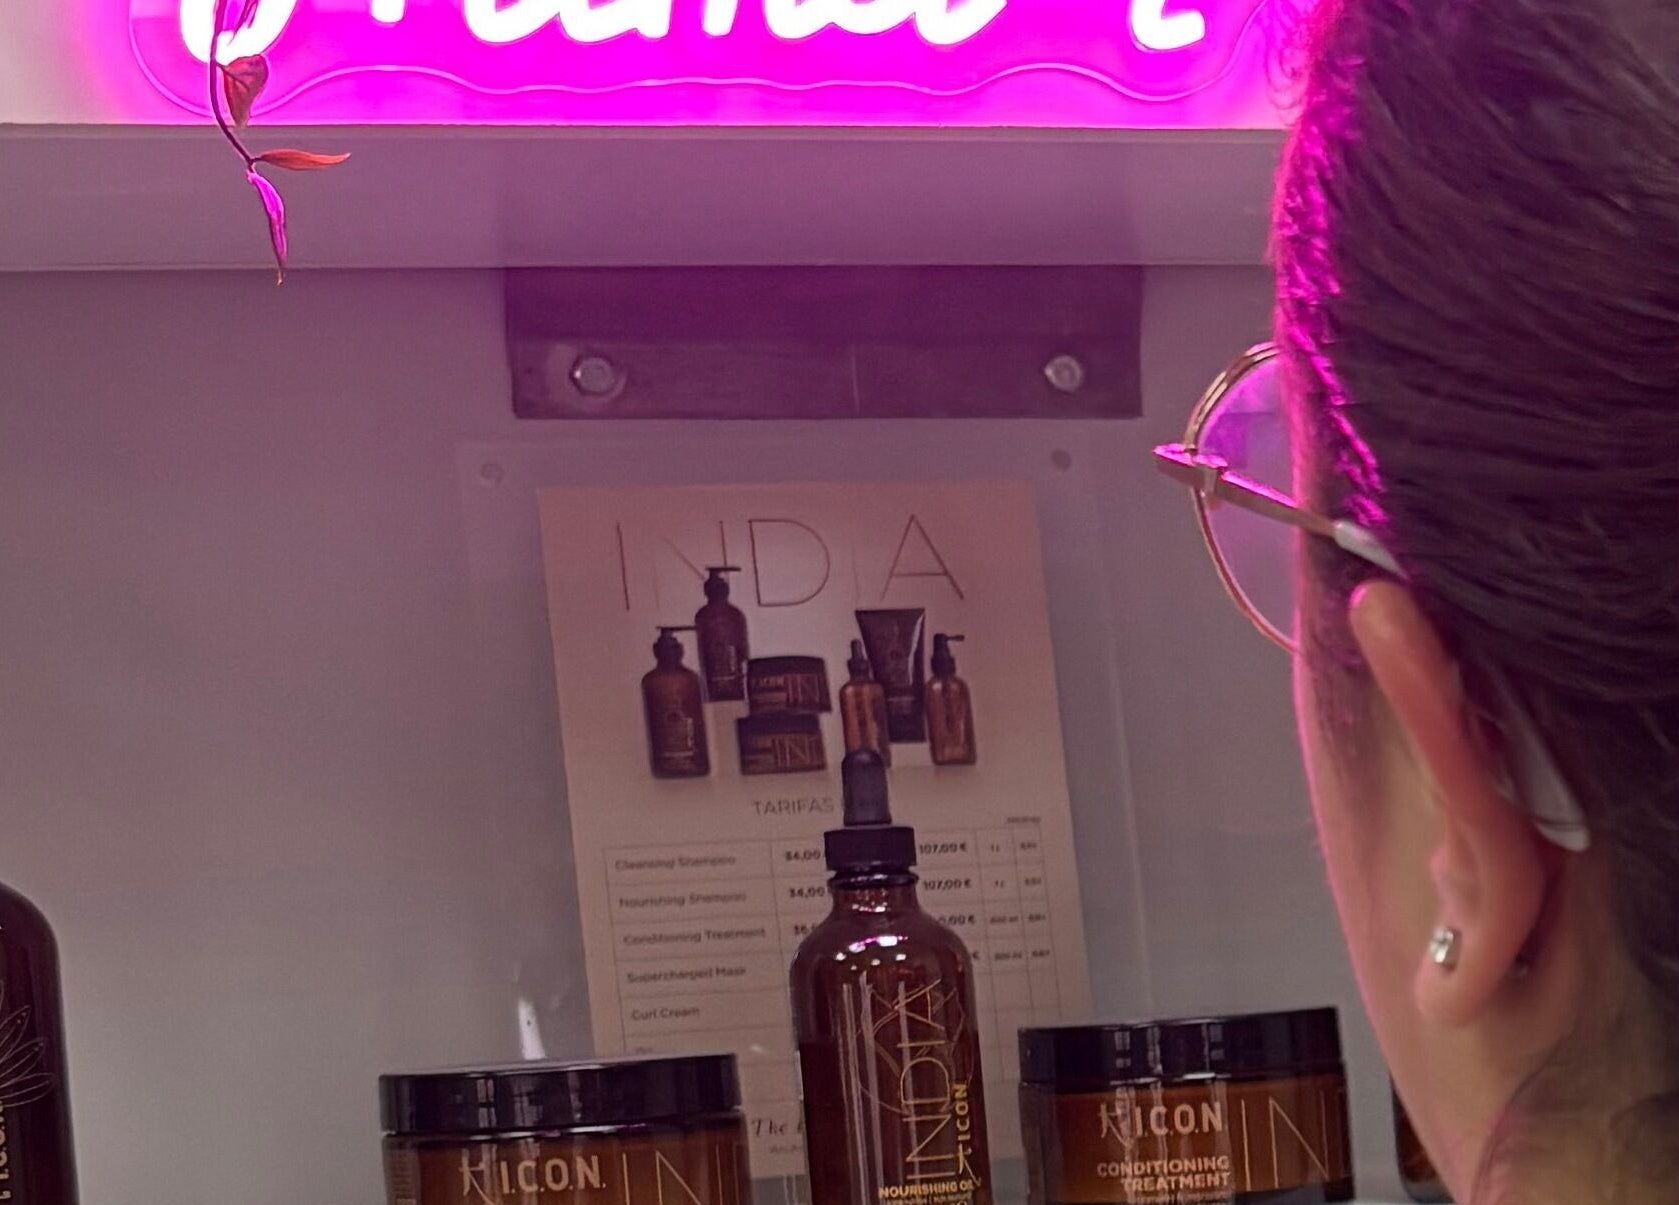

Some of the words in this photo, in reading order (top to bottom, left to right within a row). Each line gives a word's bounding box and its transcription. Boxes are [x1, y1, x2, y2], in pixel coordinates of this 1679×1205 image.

[754, 800, 834, 816] TARIFAS
[922, 880, 962, 891] 107,00
[631, 1007, 657, 1021] Curl
[660, 1006, 700, 1018] Cream
[1096, 1155, 1231, 1178] CONDITIONING
[877, 1181, 957, 1199] NOURISHING
[1121, 1171, 1232, 1192] TREATMENT
